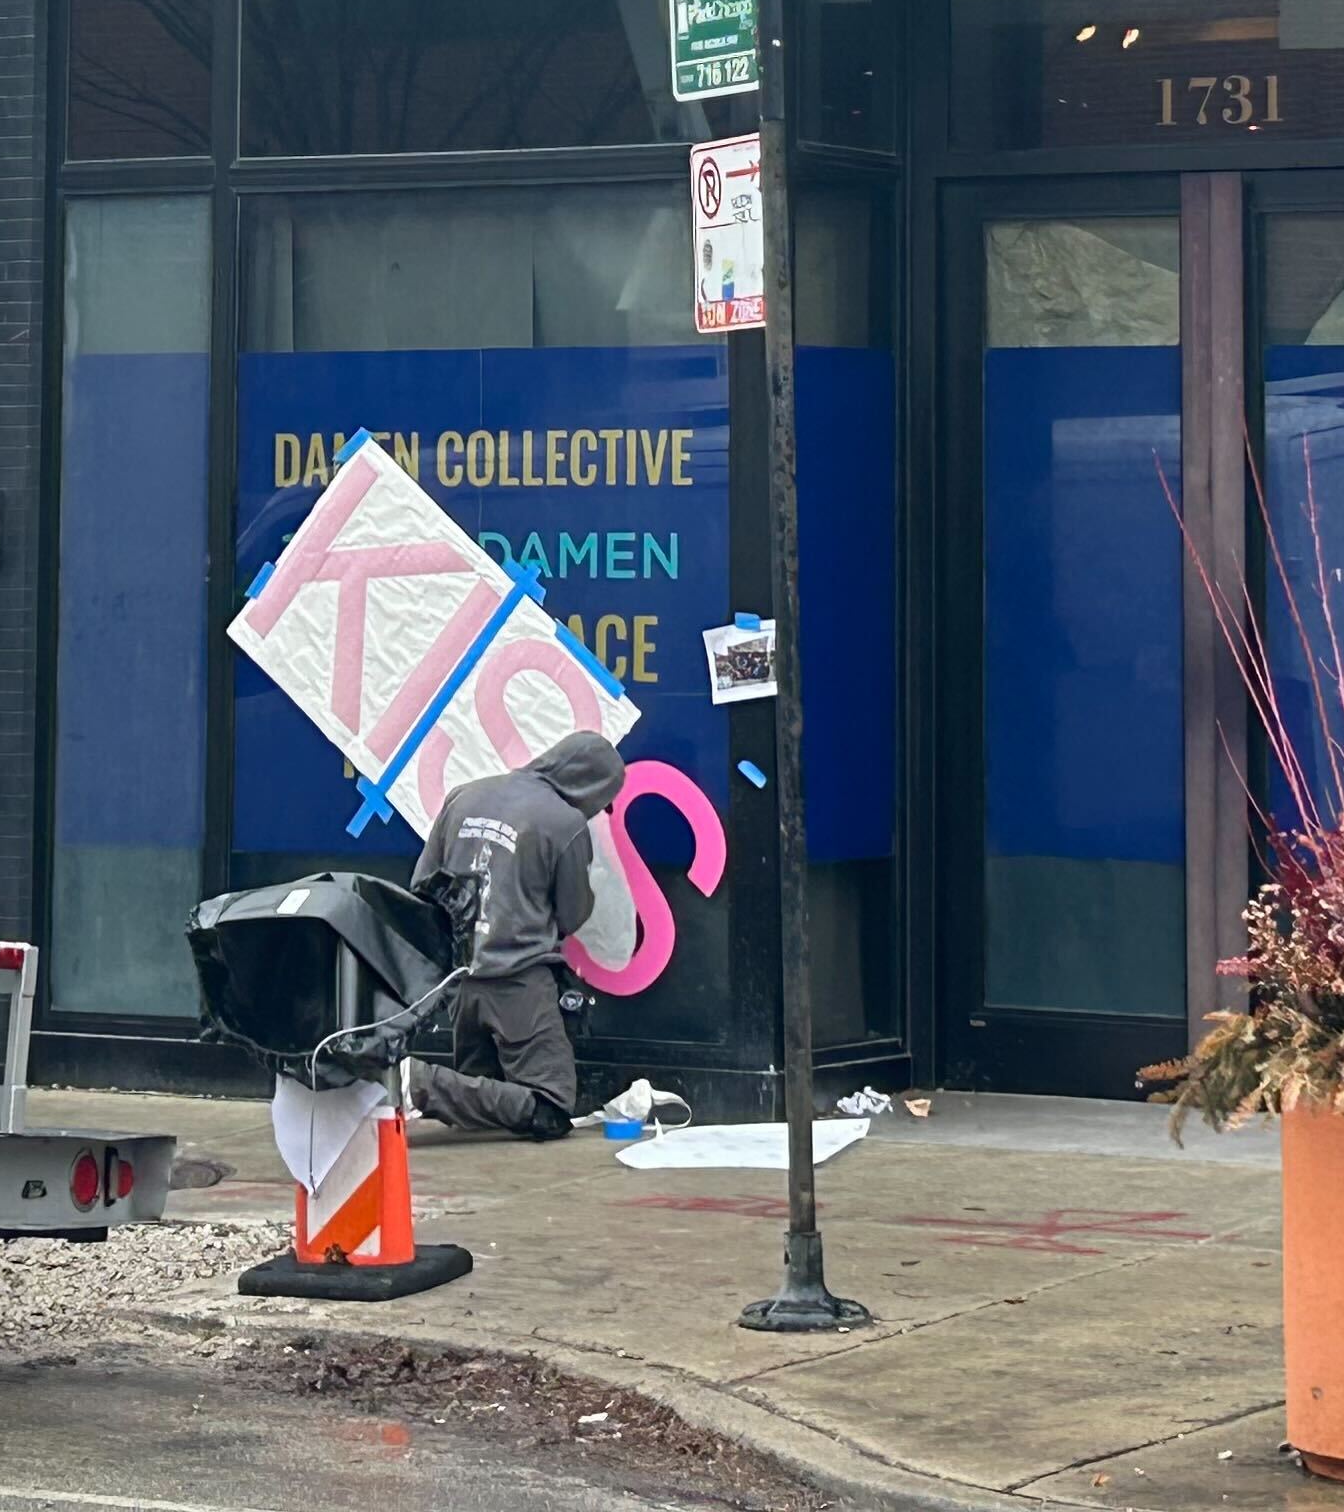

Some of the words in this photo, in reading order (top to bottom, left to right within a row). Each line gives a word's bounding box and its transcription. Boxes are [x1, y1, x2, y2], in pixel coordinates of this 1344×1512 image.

[1155, 74, 1285, 125] 1731
[274, 431, 420, 488] DAN
[436, 428, 695, 487] COLLECTIVE
